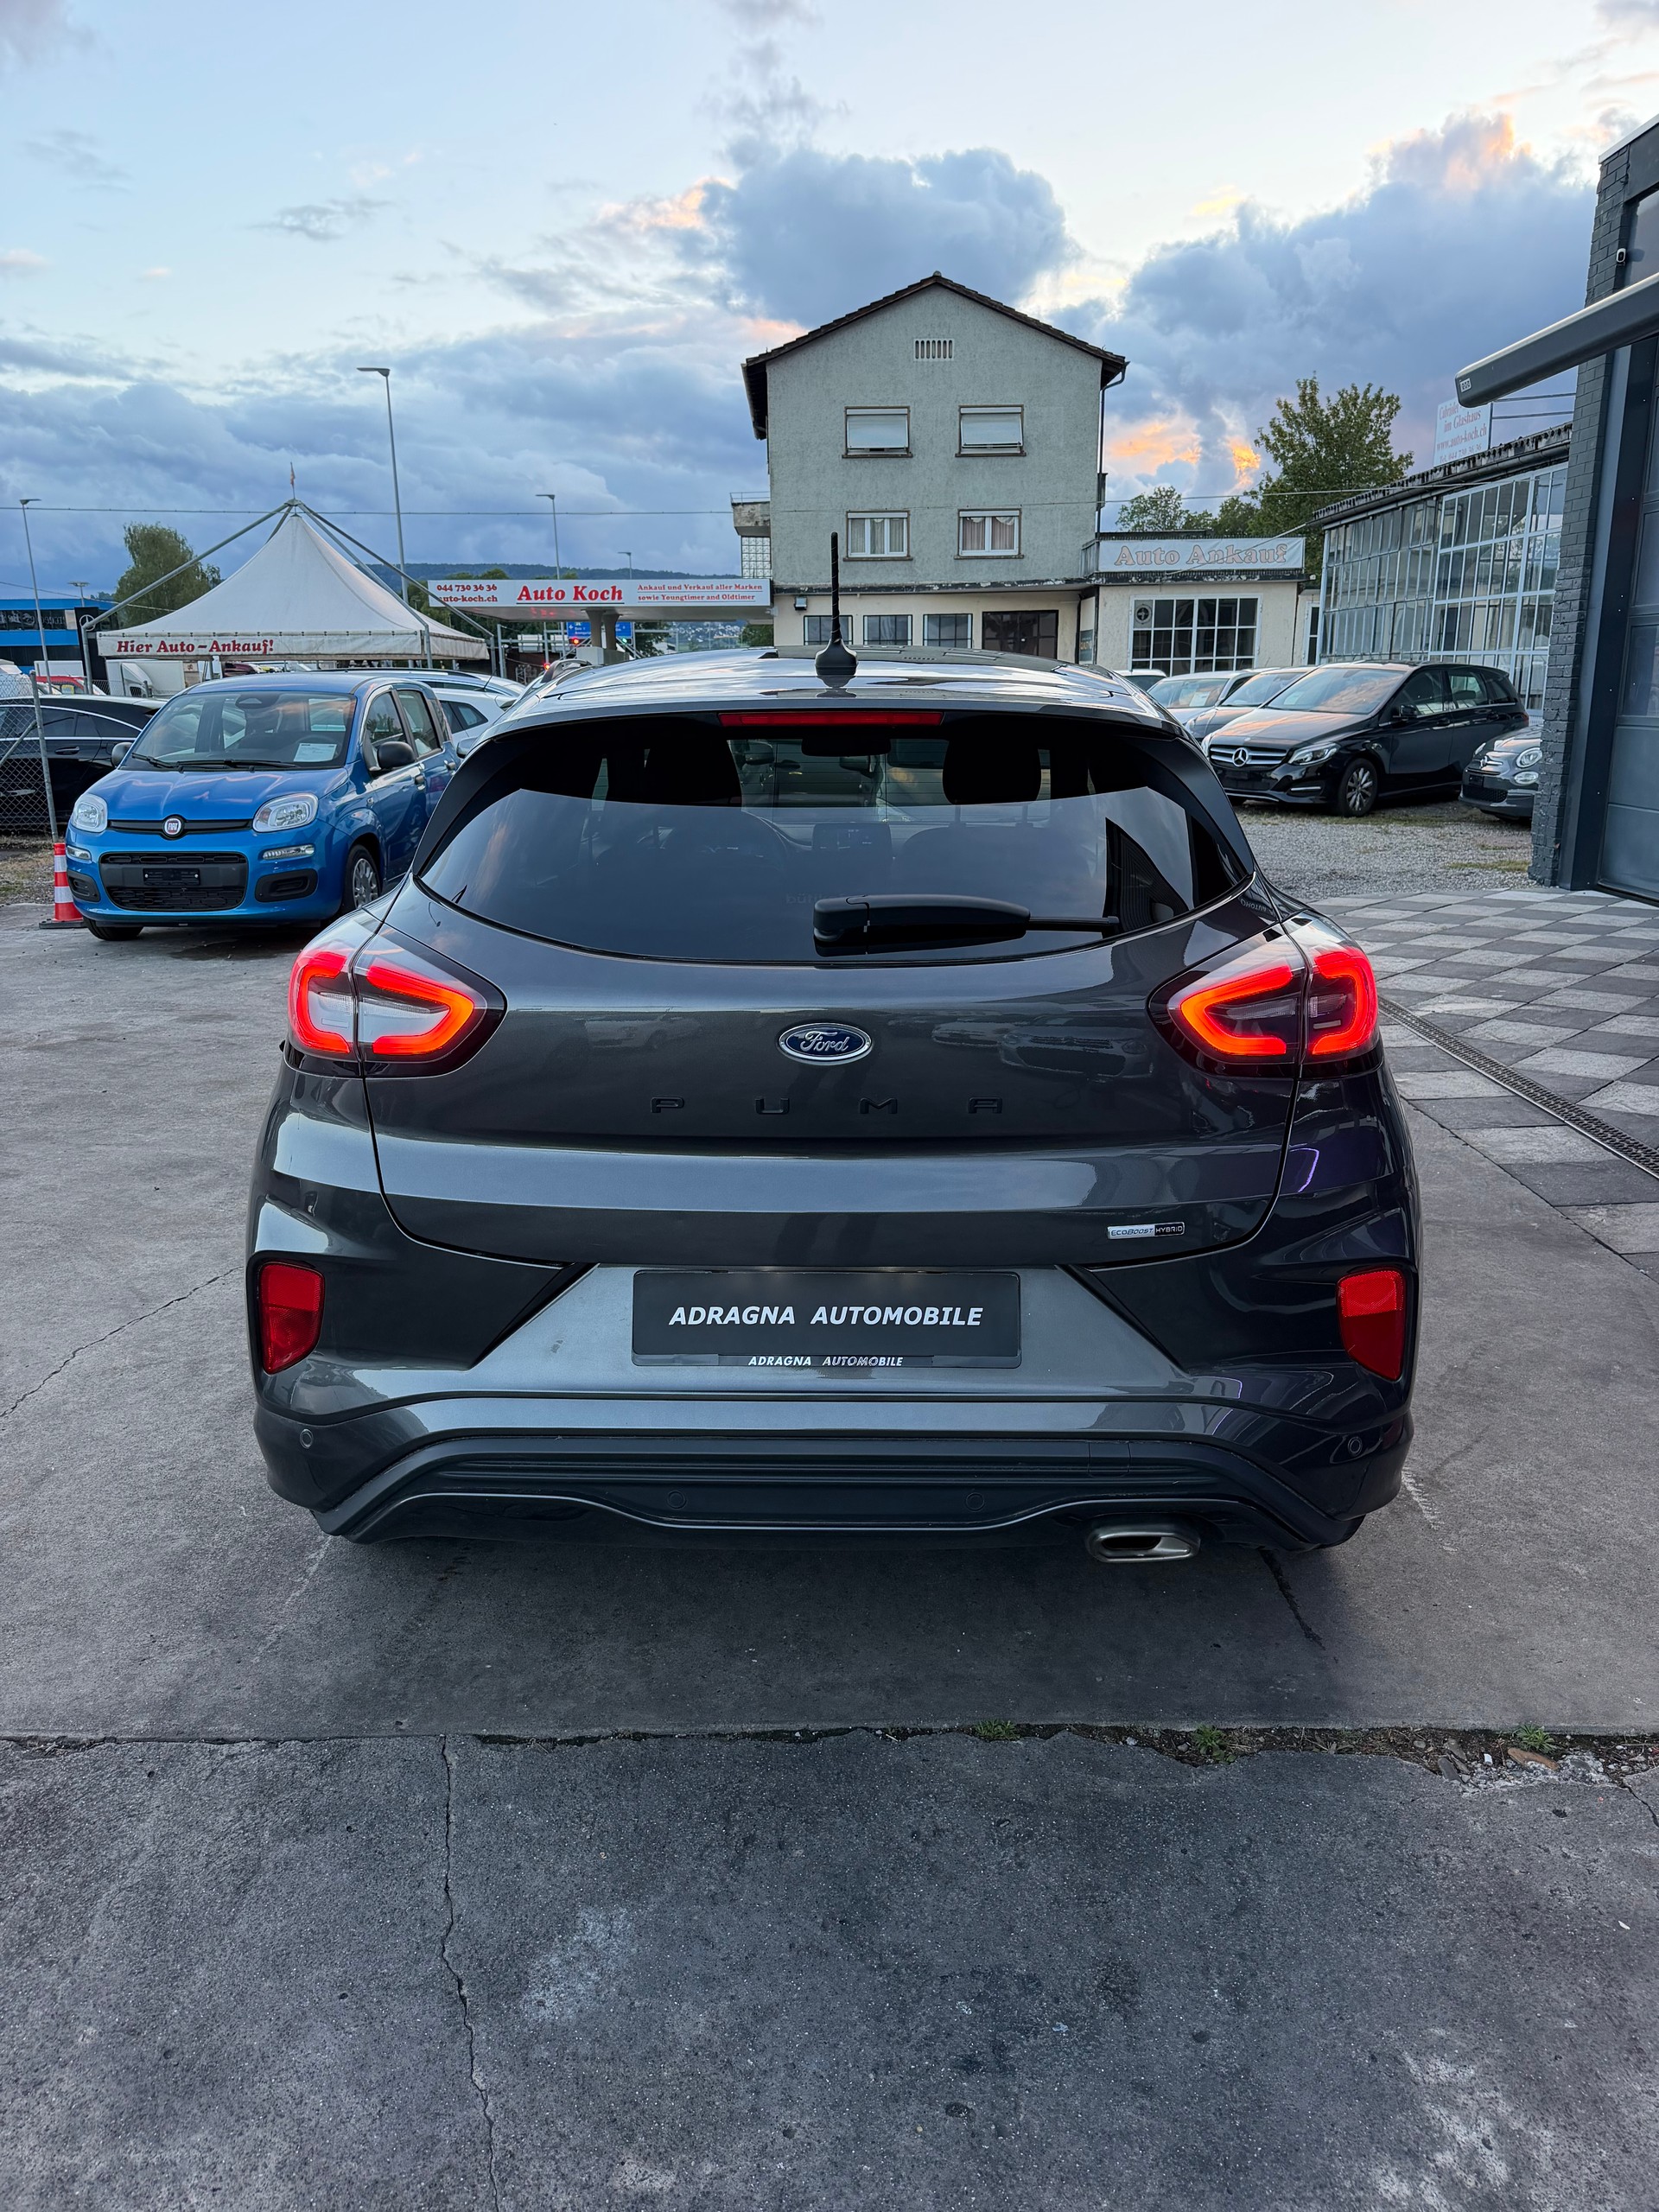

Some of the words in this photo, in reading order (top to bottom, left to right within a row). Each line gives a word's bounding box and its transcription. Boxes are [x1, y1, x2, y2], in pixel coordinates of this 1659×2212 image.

[1453, 410, 1481, 429] Glashaus
[1436, 423, 1487, 450] www.auto-koch.ch
[1115, 545, 1180, 566] Auto
[1185, 543, 1288, 565] Ankauf
[517, 585, 566, 601] Auto
[573, 585, 623, 601] Koch
[117, 640, 153, 652] Hier
[799, 1031, 850, 1052] Ford
[651, 1096, 1003, 1115] PUMA
[669, 1306, 795, 1325] ADRAGNA
[810, 1306, 983, 1326] AUTOMOBILE
[748, 1356, 811, 1366] ADRAGNA
[822, 1356, 903, 1367] AUTOMOBILE
